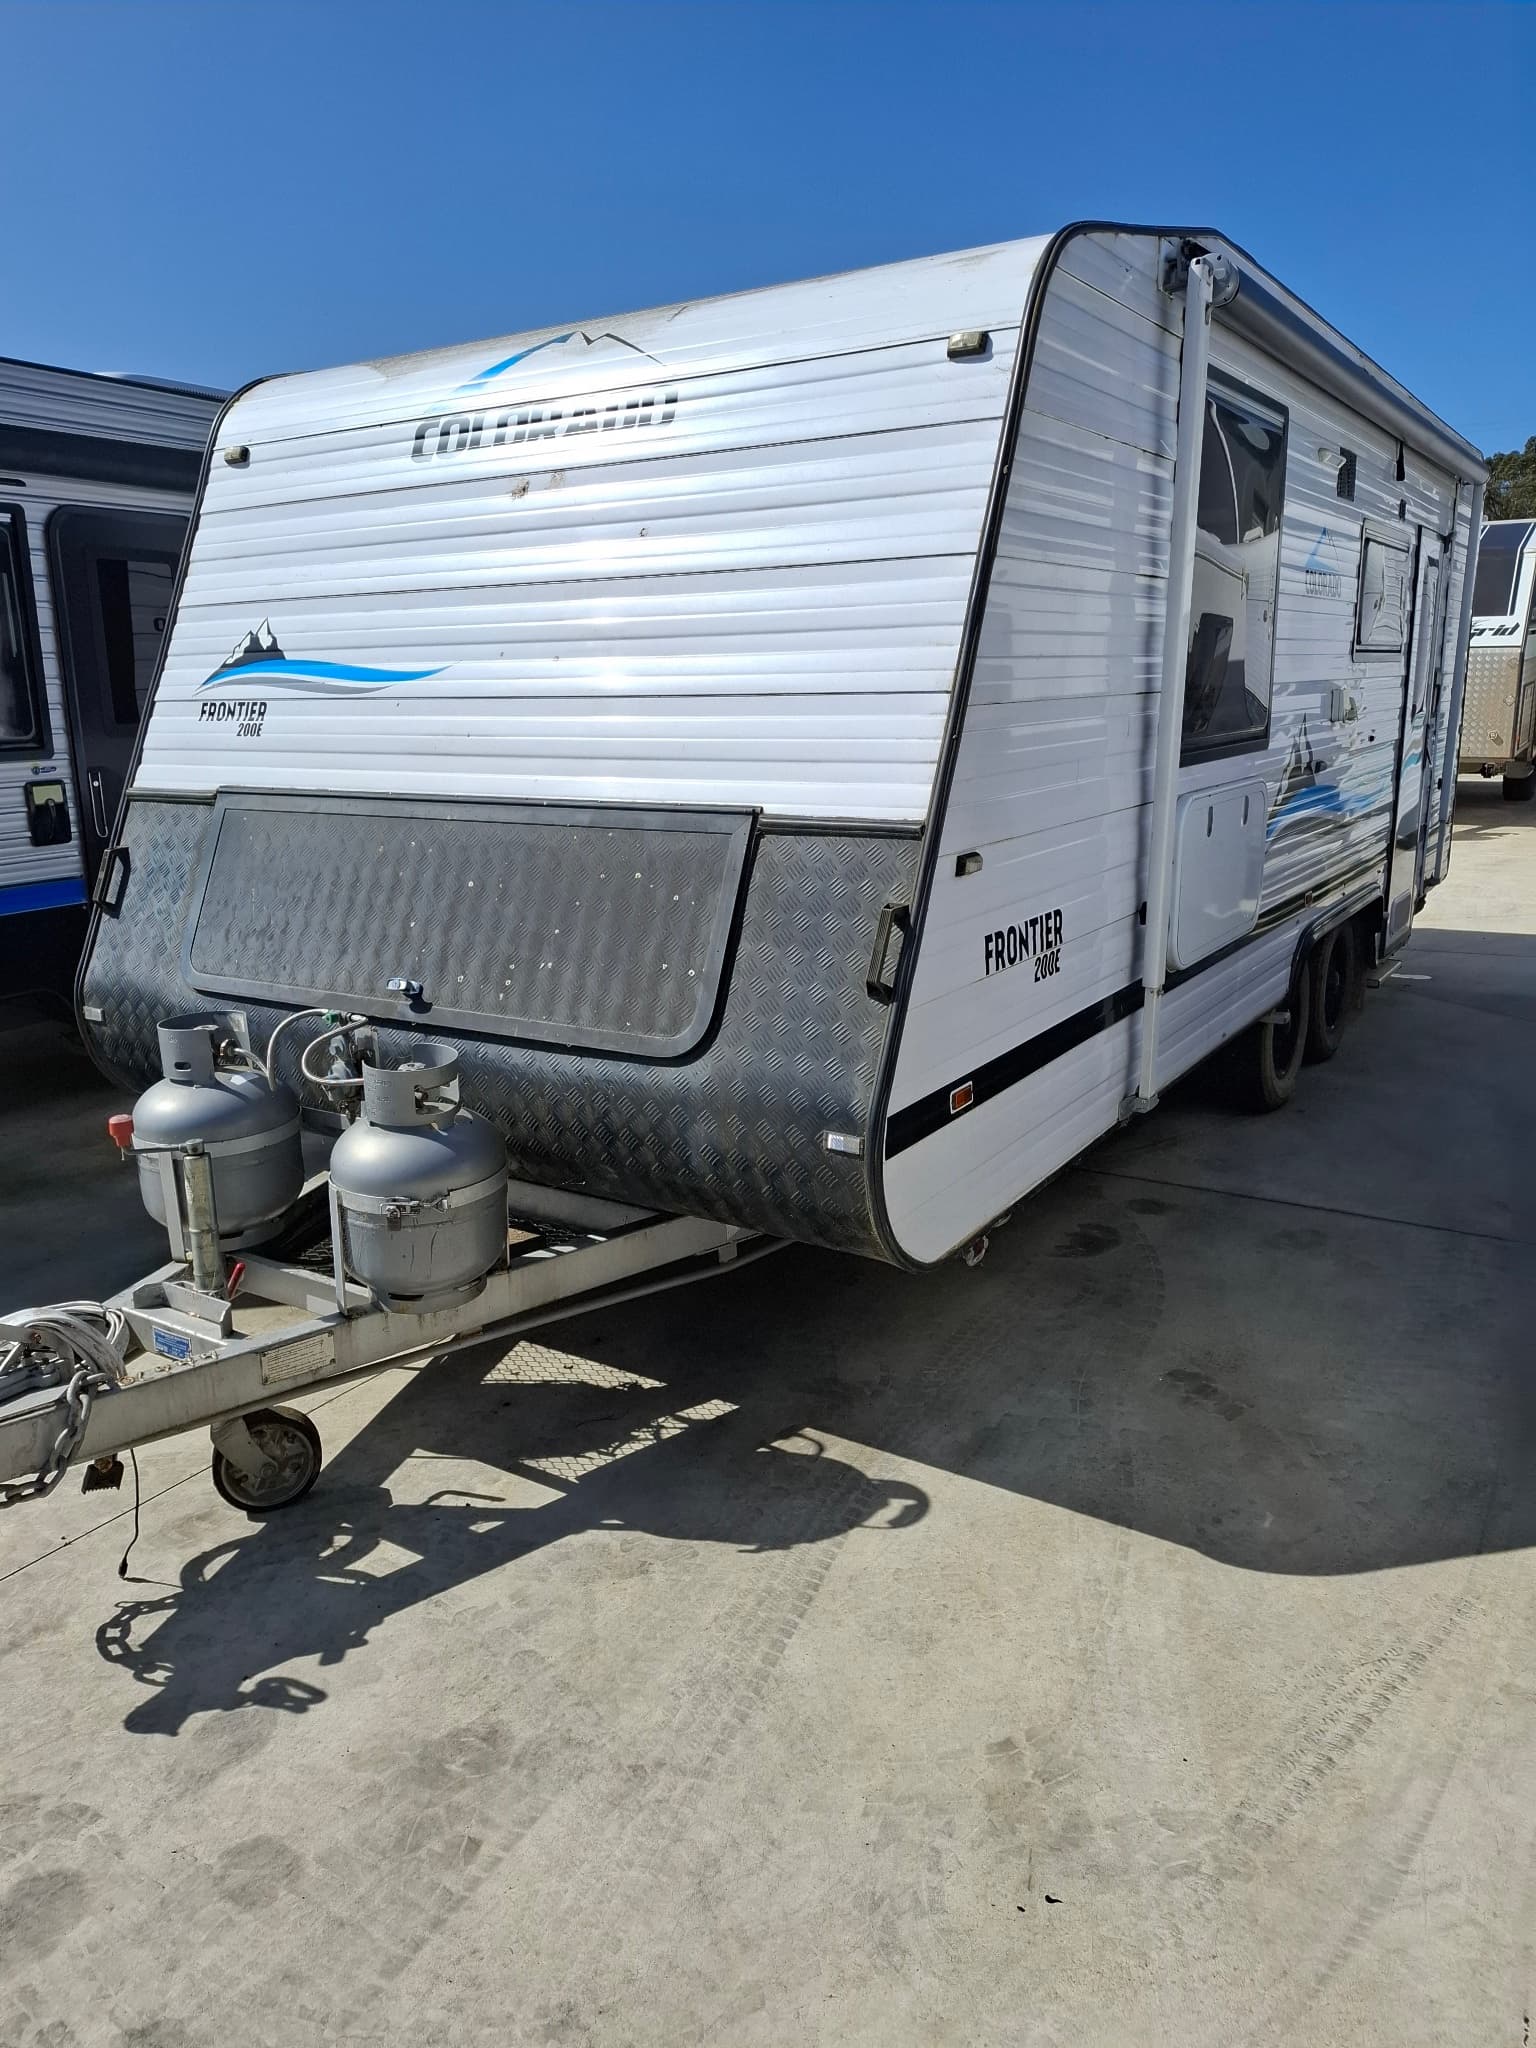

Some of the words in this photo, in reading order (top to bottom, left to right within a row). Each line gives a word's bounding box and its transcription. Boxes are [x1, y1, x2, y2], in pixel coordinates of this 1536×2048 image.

[198, 701, 268, 722] FRONTIER
[236, 722, 263, 737] 200E
[984, 908, 1063, 976] FRONTIER
[1034, 948, 1061, 983] 200E
